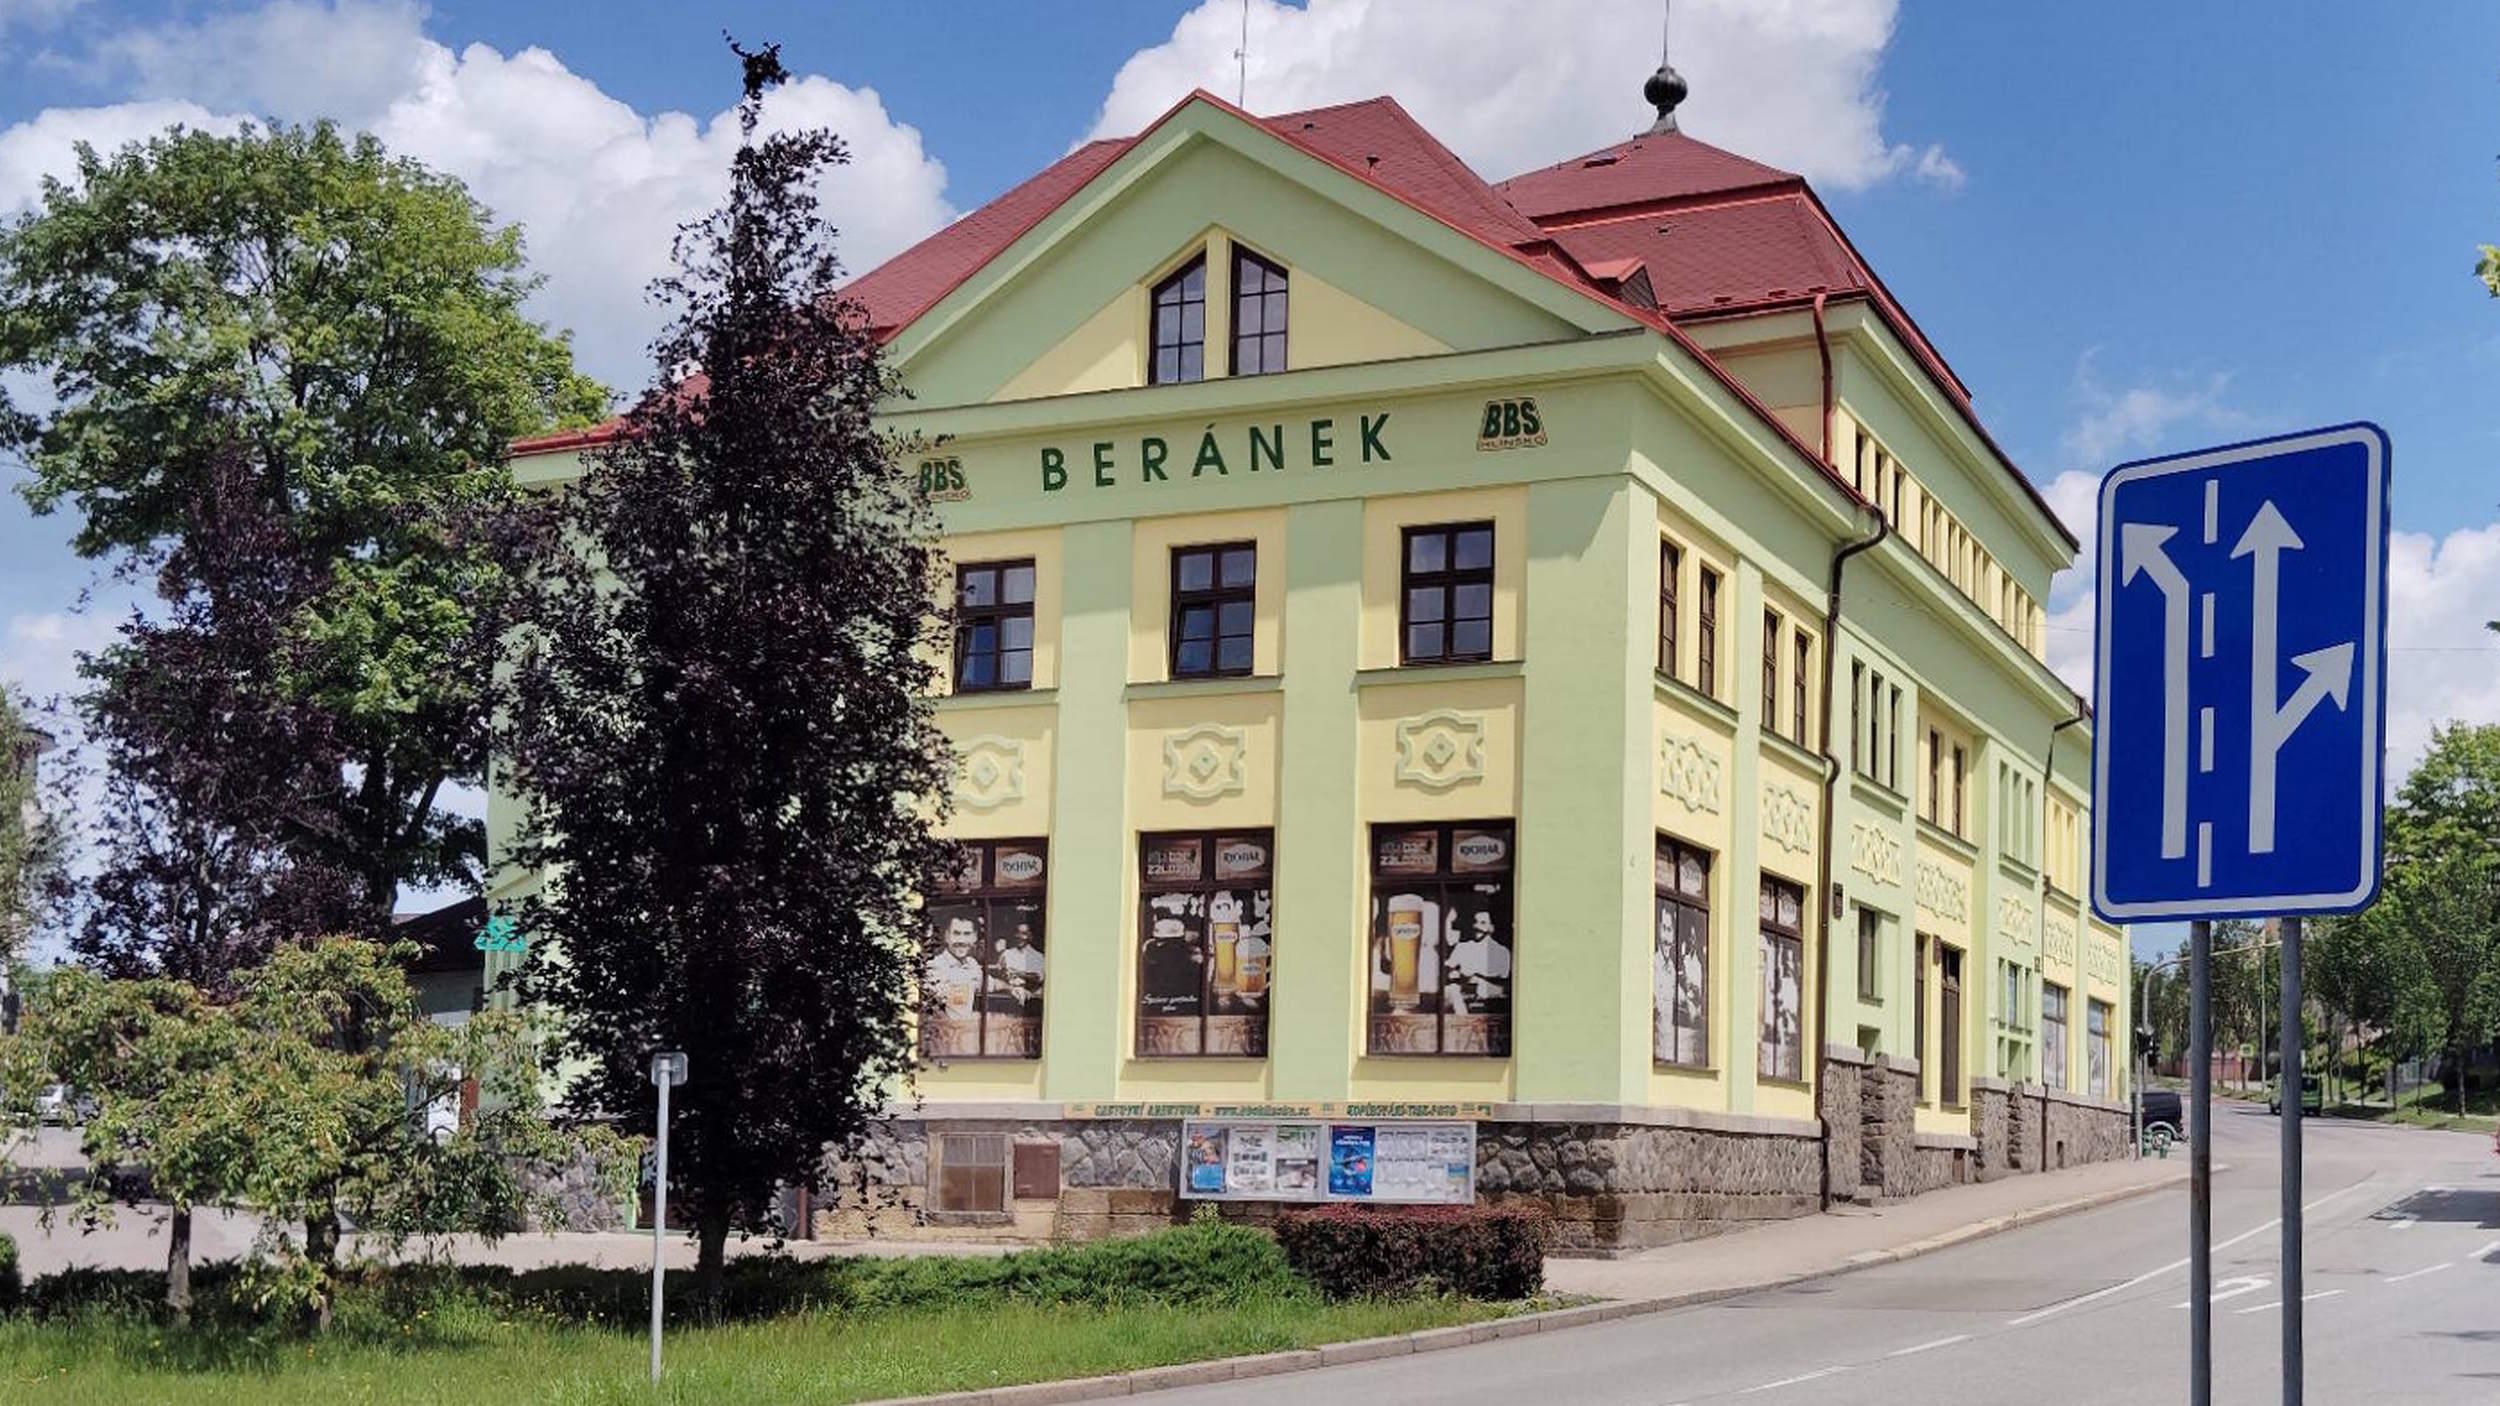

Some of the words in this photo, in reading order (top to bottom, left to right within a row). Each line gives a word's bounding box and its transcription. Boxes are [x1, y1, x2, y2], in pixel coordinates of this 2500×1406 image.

[1482, 400, 1541, 439] BBS
[1041, 413, 1392, 492] BERÁNEK
[919, 459, 966, 492] BBS
